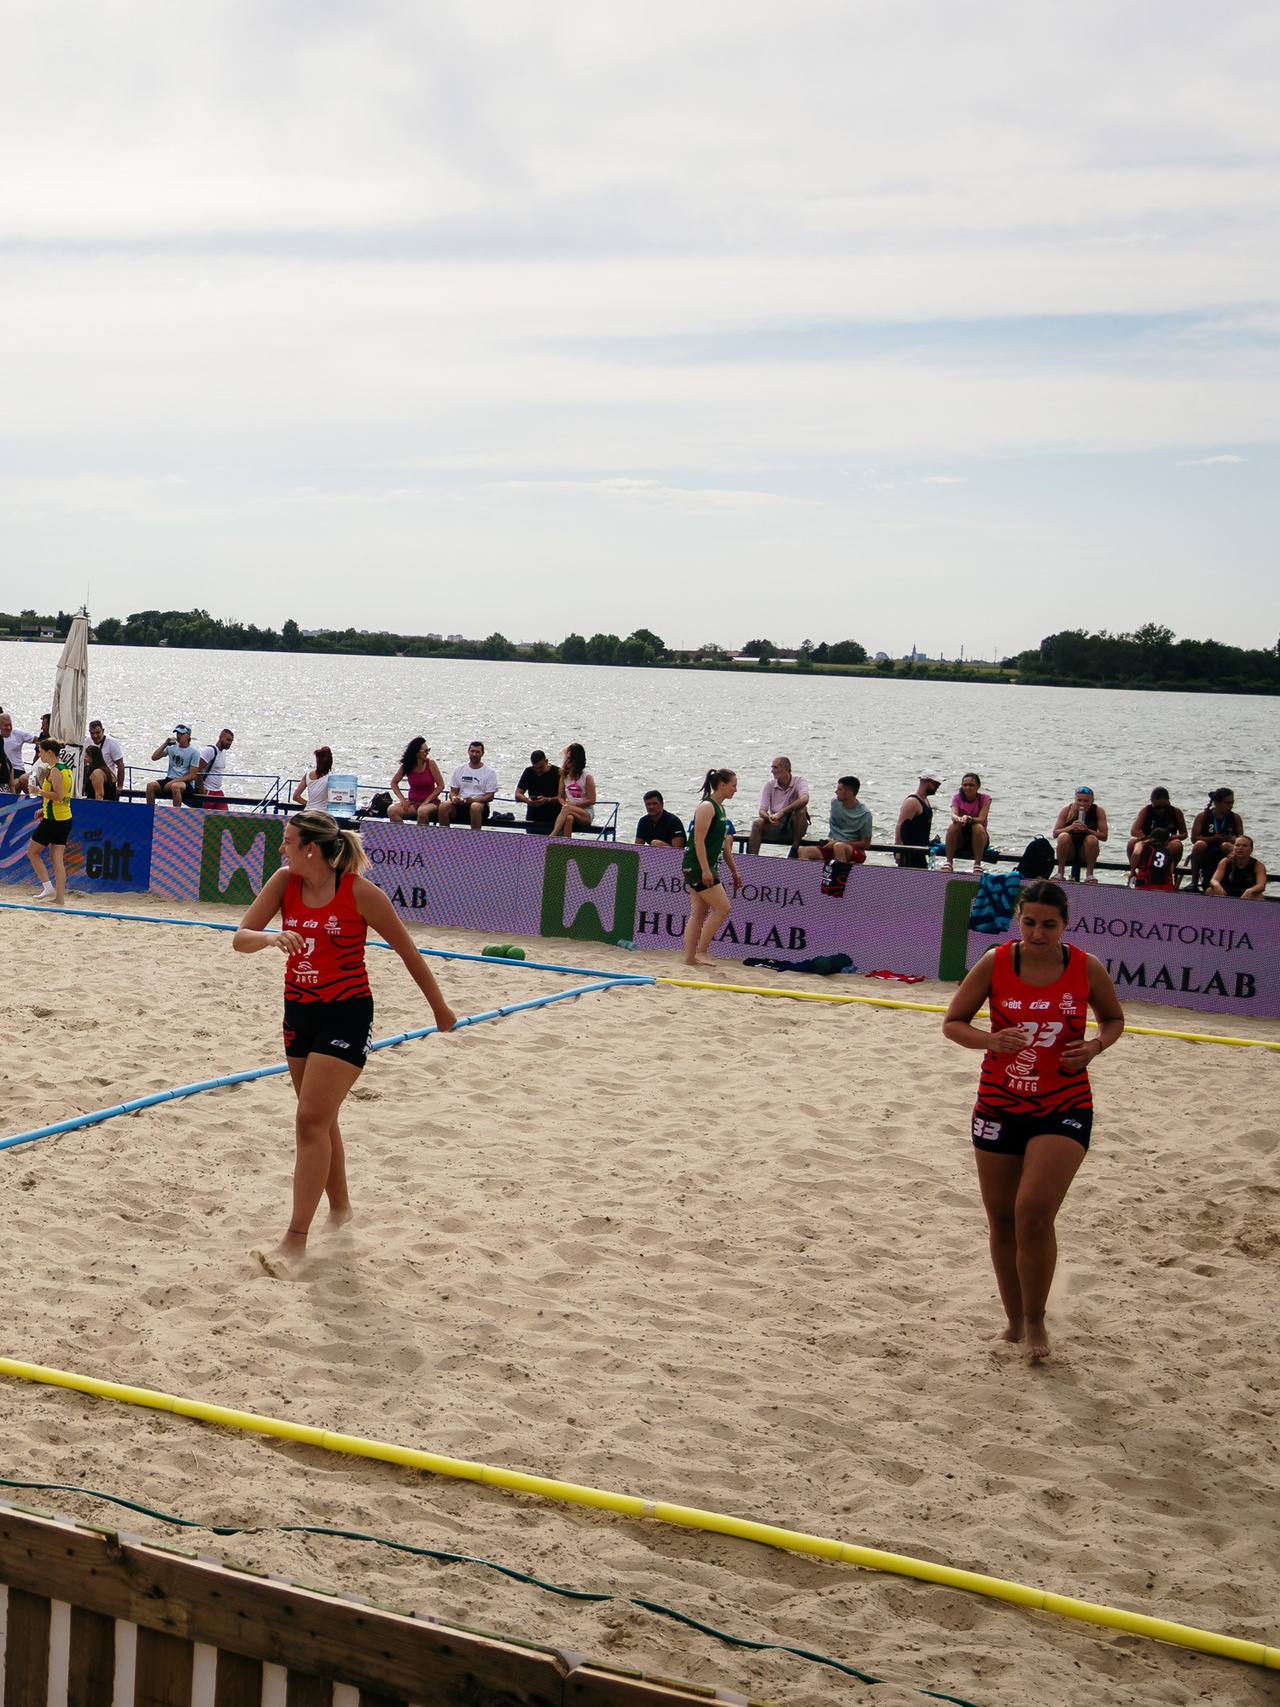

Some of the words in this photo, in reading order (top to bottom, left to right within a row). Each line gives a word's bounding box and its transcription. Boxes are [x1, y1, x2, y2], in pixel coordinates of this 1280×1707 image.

[86, 840, 135, 883] ebt
[1154, 851, 1166, 868] 3
[638, 911, 807, 951] HUALAB
[1065, 916, 1254, 952] ABORATORIJA
[1017, 1022, 1064, 1048] 33
[973, 1118, 1002, 1141] 33
